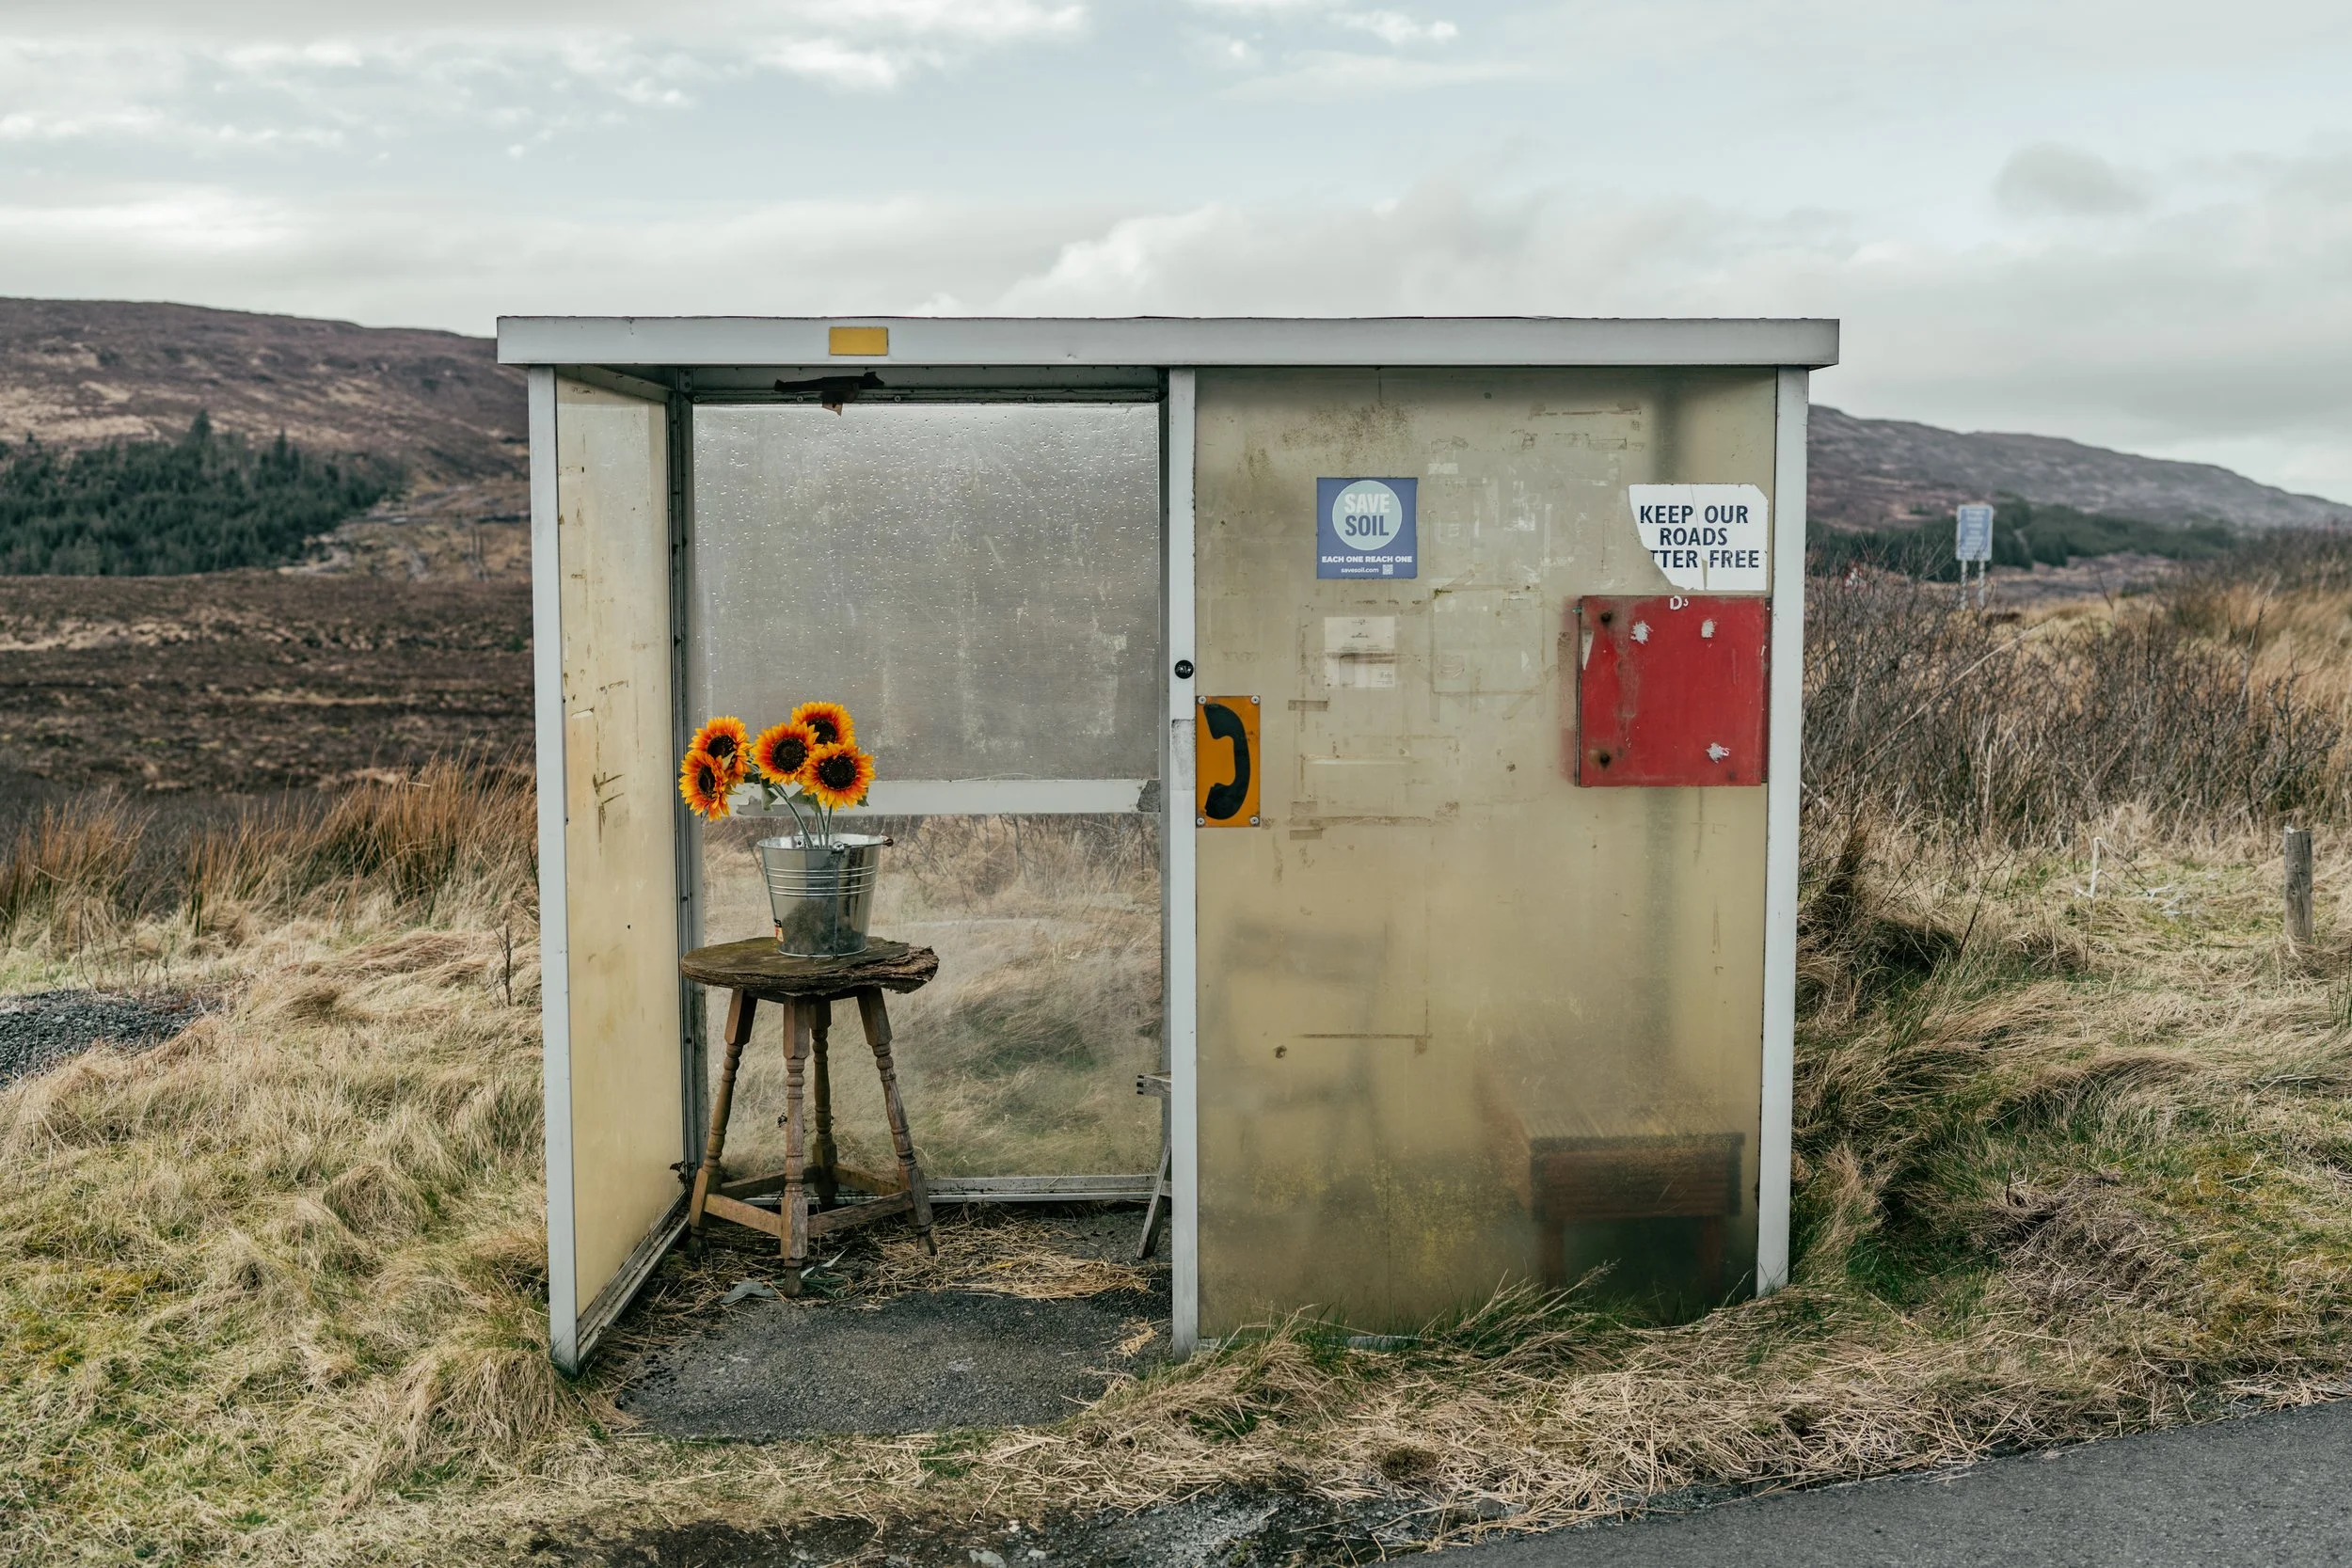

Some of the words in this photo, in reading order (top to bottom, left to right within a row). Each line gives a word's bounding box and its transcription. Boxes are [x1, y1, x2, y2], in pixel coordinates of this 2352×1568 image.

[1343, 493, 1391, 514] SAVE
[1640, 505, 1693, 524] KEEP
[1704, 505, 1749, 524] OUR
[1344, 515, 1390, 537] SOIL
[1660, 527, 1728, 546] ROADS
[1708, 549, 1759, 568] FREE
